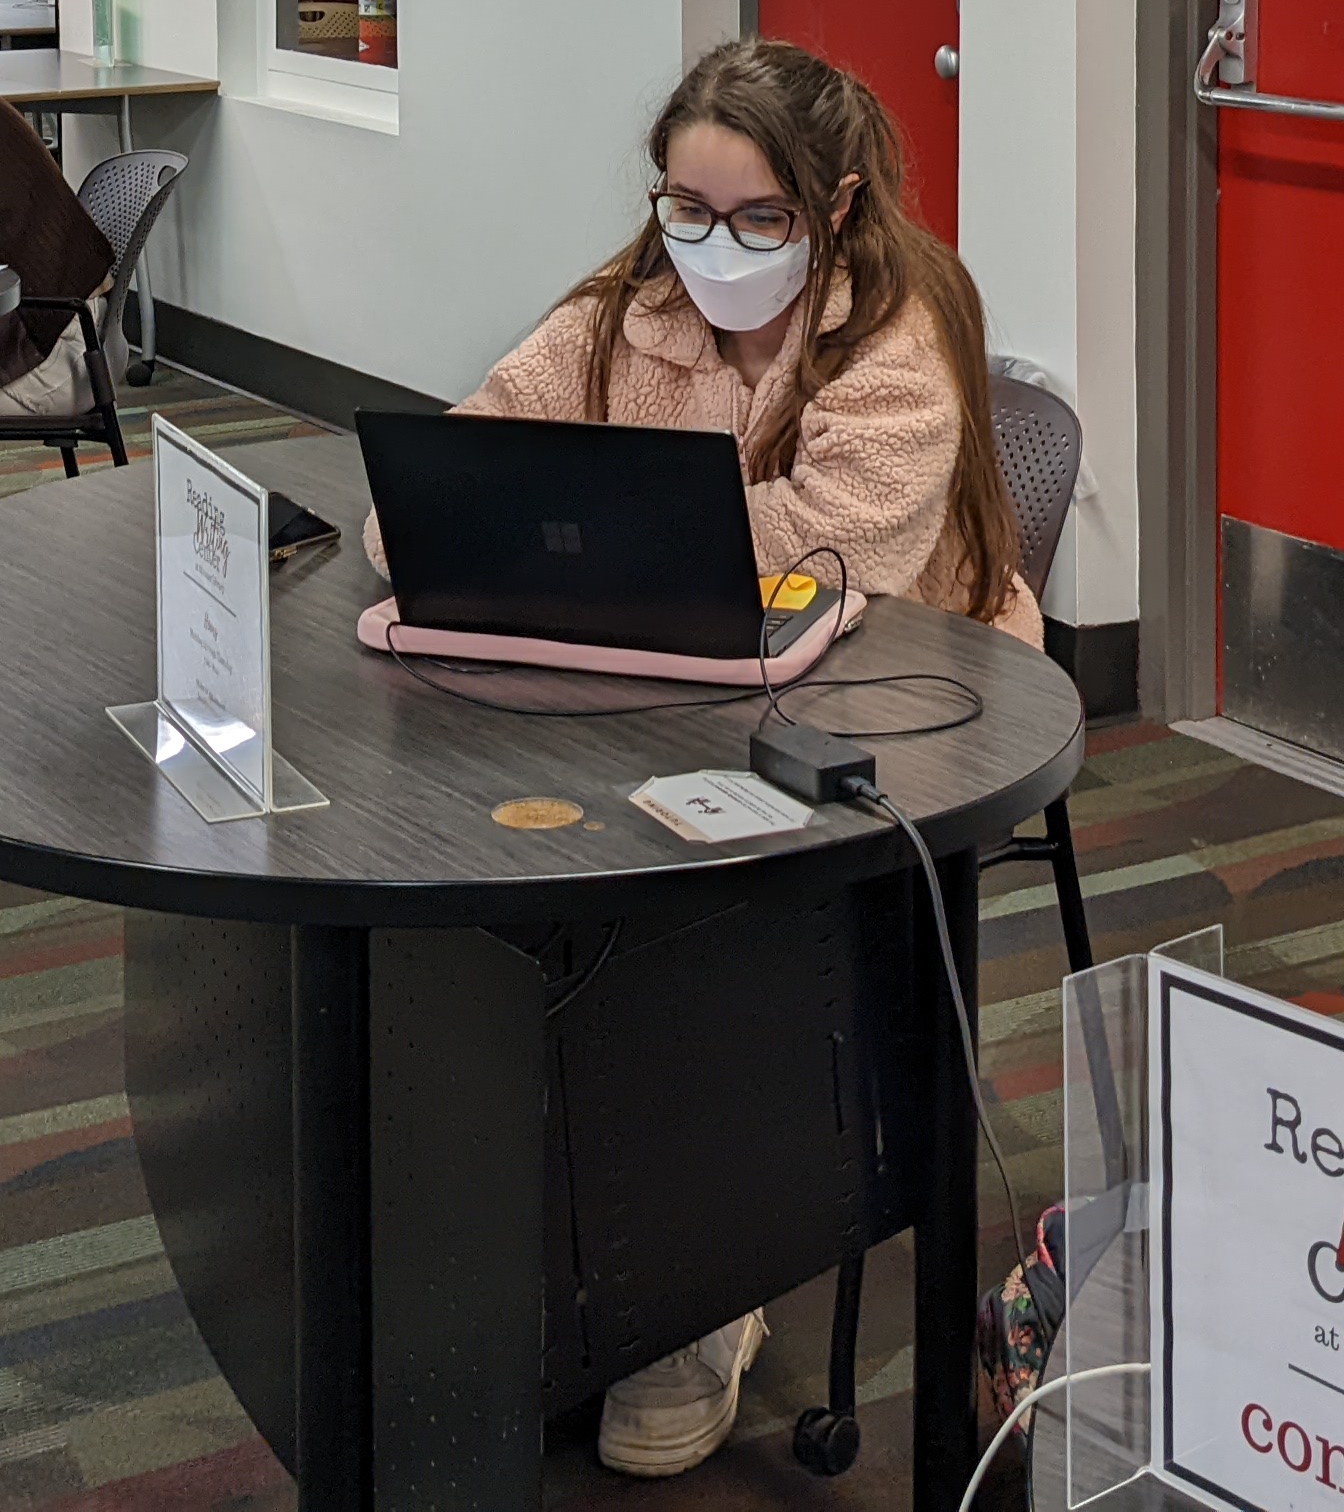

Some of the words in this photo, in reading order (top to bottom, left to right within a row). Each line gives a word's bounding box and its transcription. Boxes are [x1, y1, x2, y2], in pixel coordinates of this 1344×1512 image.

[186, 478, 225, 536] Reading
[193, 531, 221, 572] Center
[1314, 1325, 1340, 1351] at
